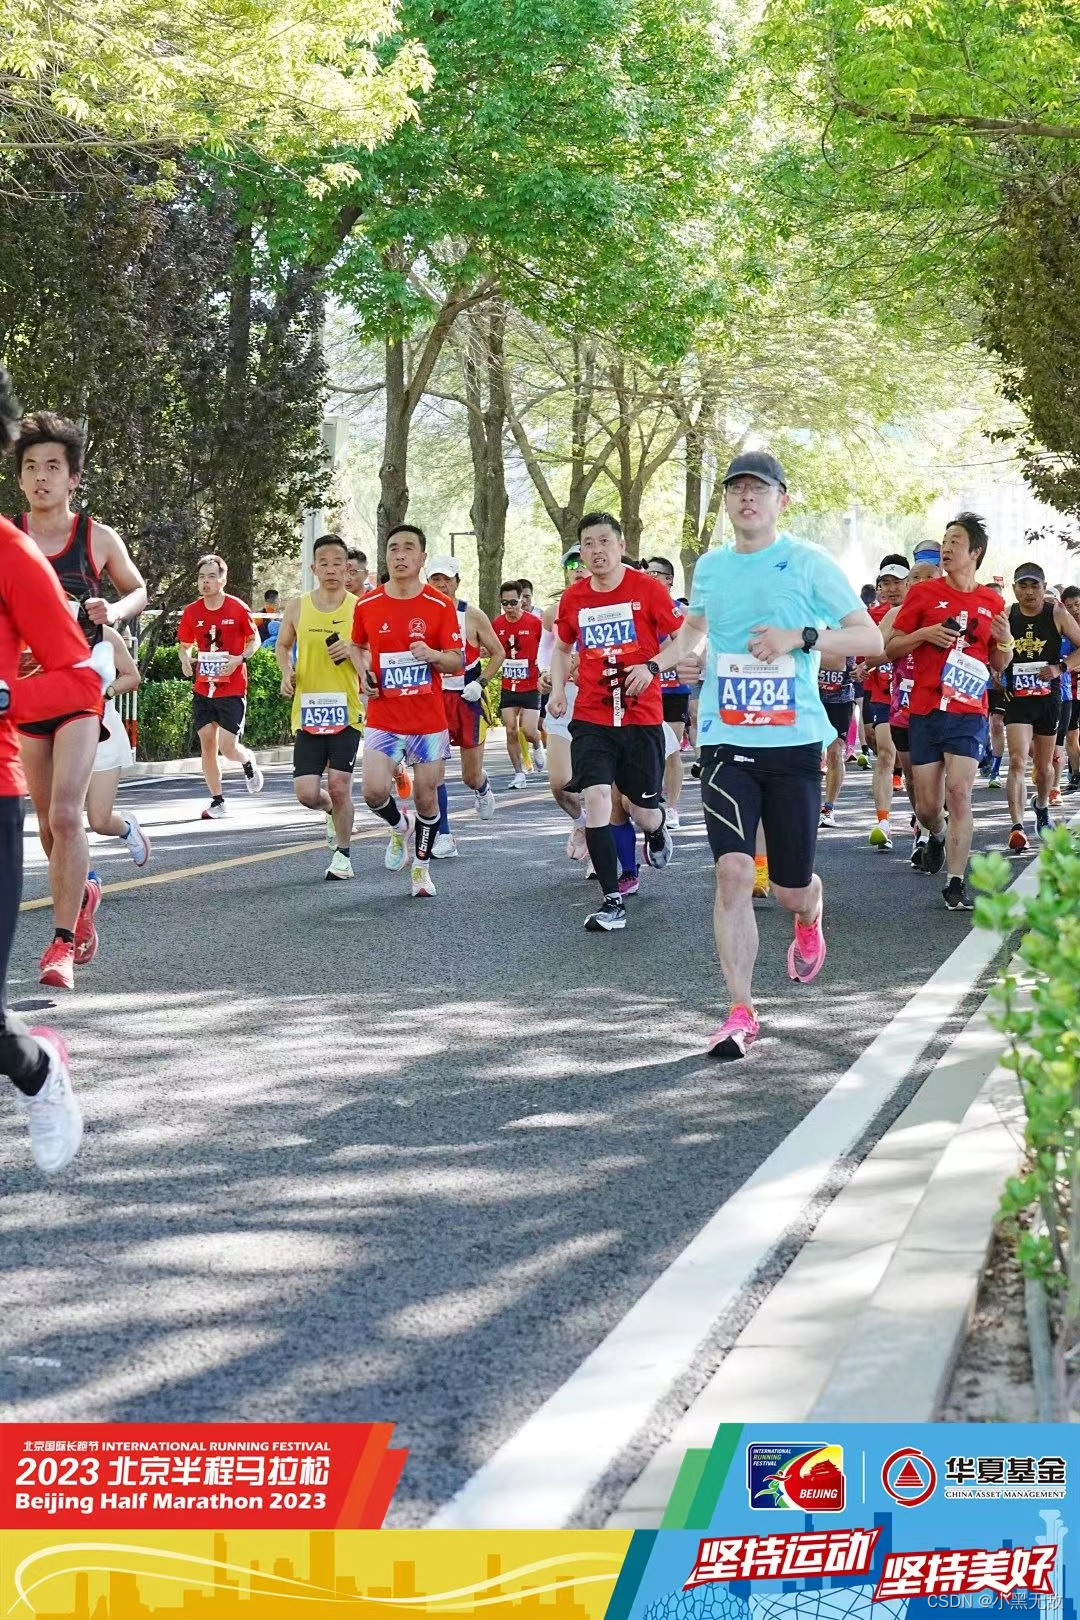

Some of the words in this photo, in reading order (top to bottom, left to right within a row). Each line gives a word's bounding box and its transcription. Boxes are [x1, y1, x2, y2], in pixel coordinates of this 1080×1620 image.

[585, 621, 630, 646] A3217
[384, 665, 428, 686] A0477
[503, 667, 527, 679] A0134
[944, 666, 985, 696] A3777
[722, 679, 790, 706] A1284
[304, 707, 345, 724] A5219
